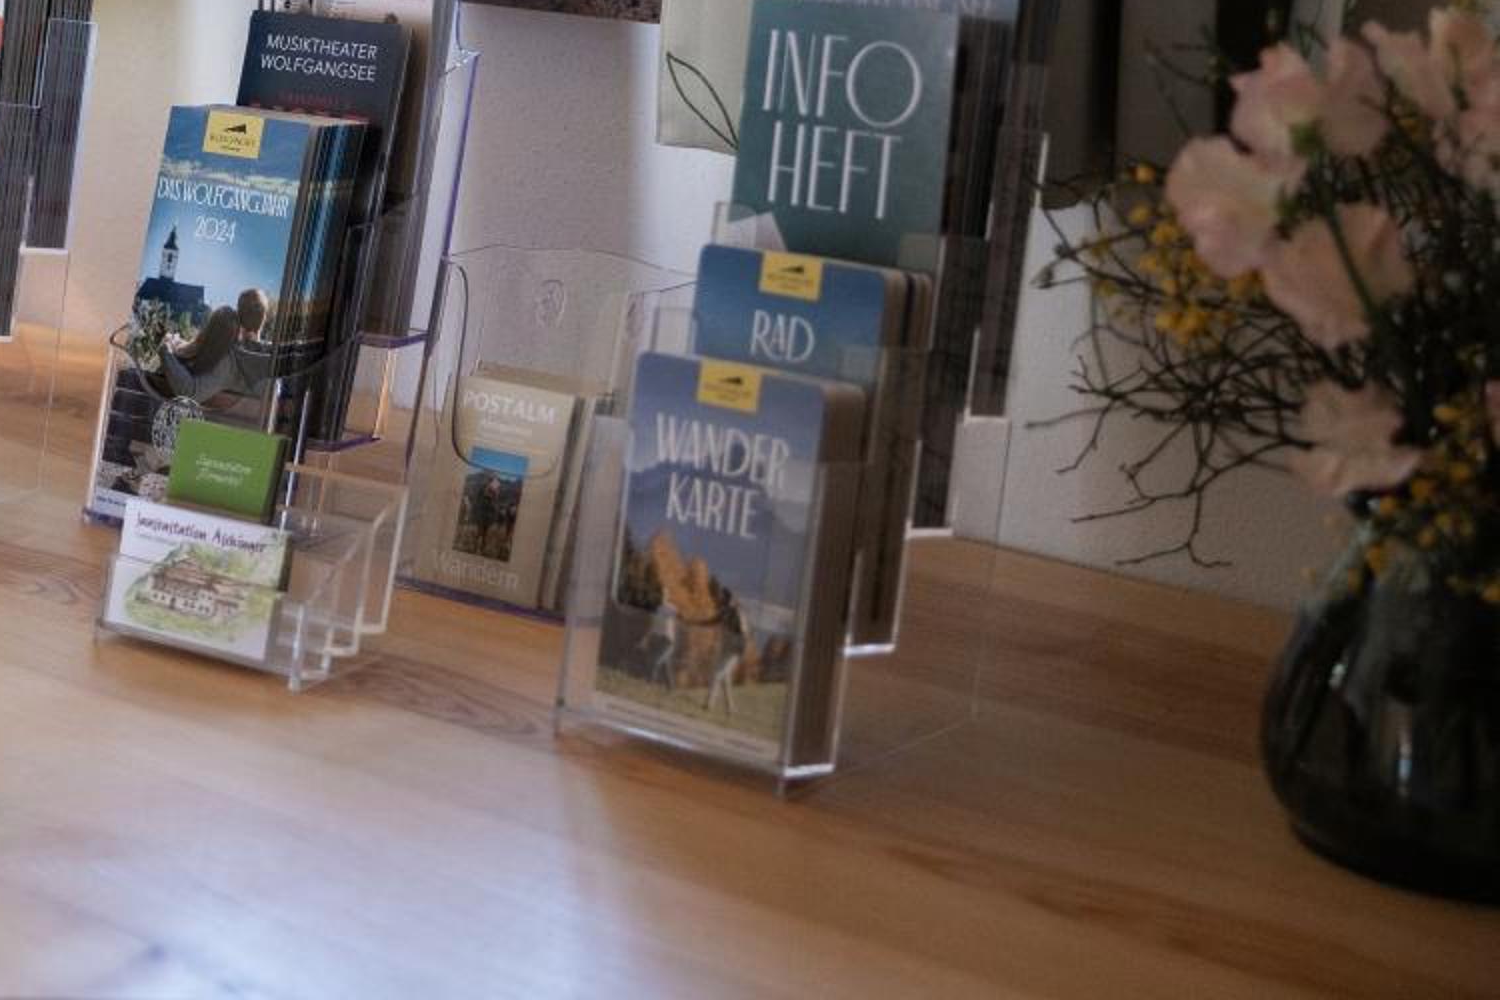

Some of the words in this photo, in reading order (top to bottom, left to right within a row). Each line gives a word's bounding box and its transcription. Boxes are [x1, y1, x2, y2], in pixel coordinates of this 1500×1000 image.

[260, 54, 377, 83] WOLFGANGSEE
[266, 33, 378, 61] MUSIKTHEATER
[762, 28, 923, 129] INFO
[157, 177, 181, 201] DAS
[767, 120, 903, 220] HEFT
[194, 215, 237, 244] 2024
[751, 309, 815, 363] RAD
[463, 391, 556, 425] POSTALM
[656, 411, 790, 491] WANDER
[665, 471, 758, 540] KARTE
